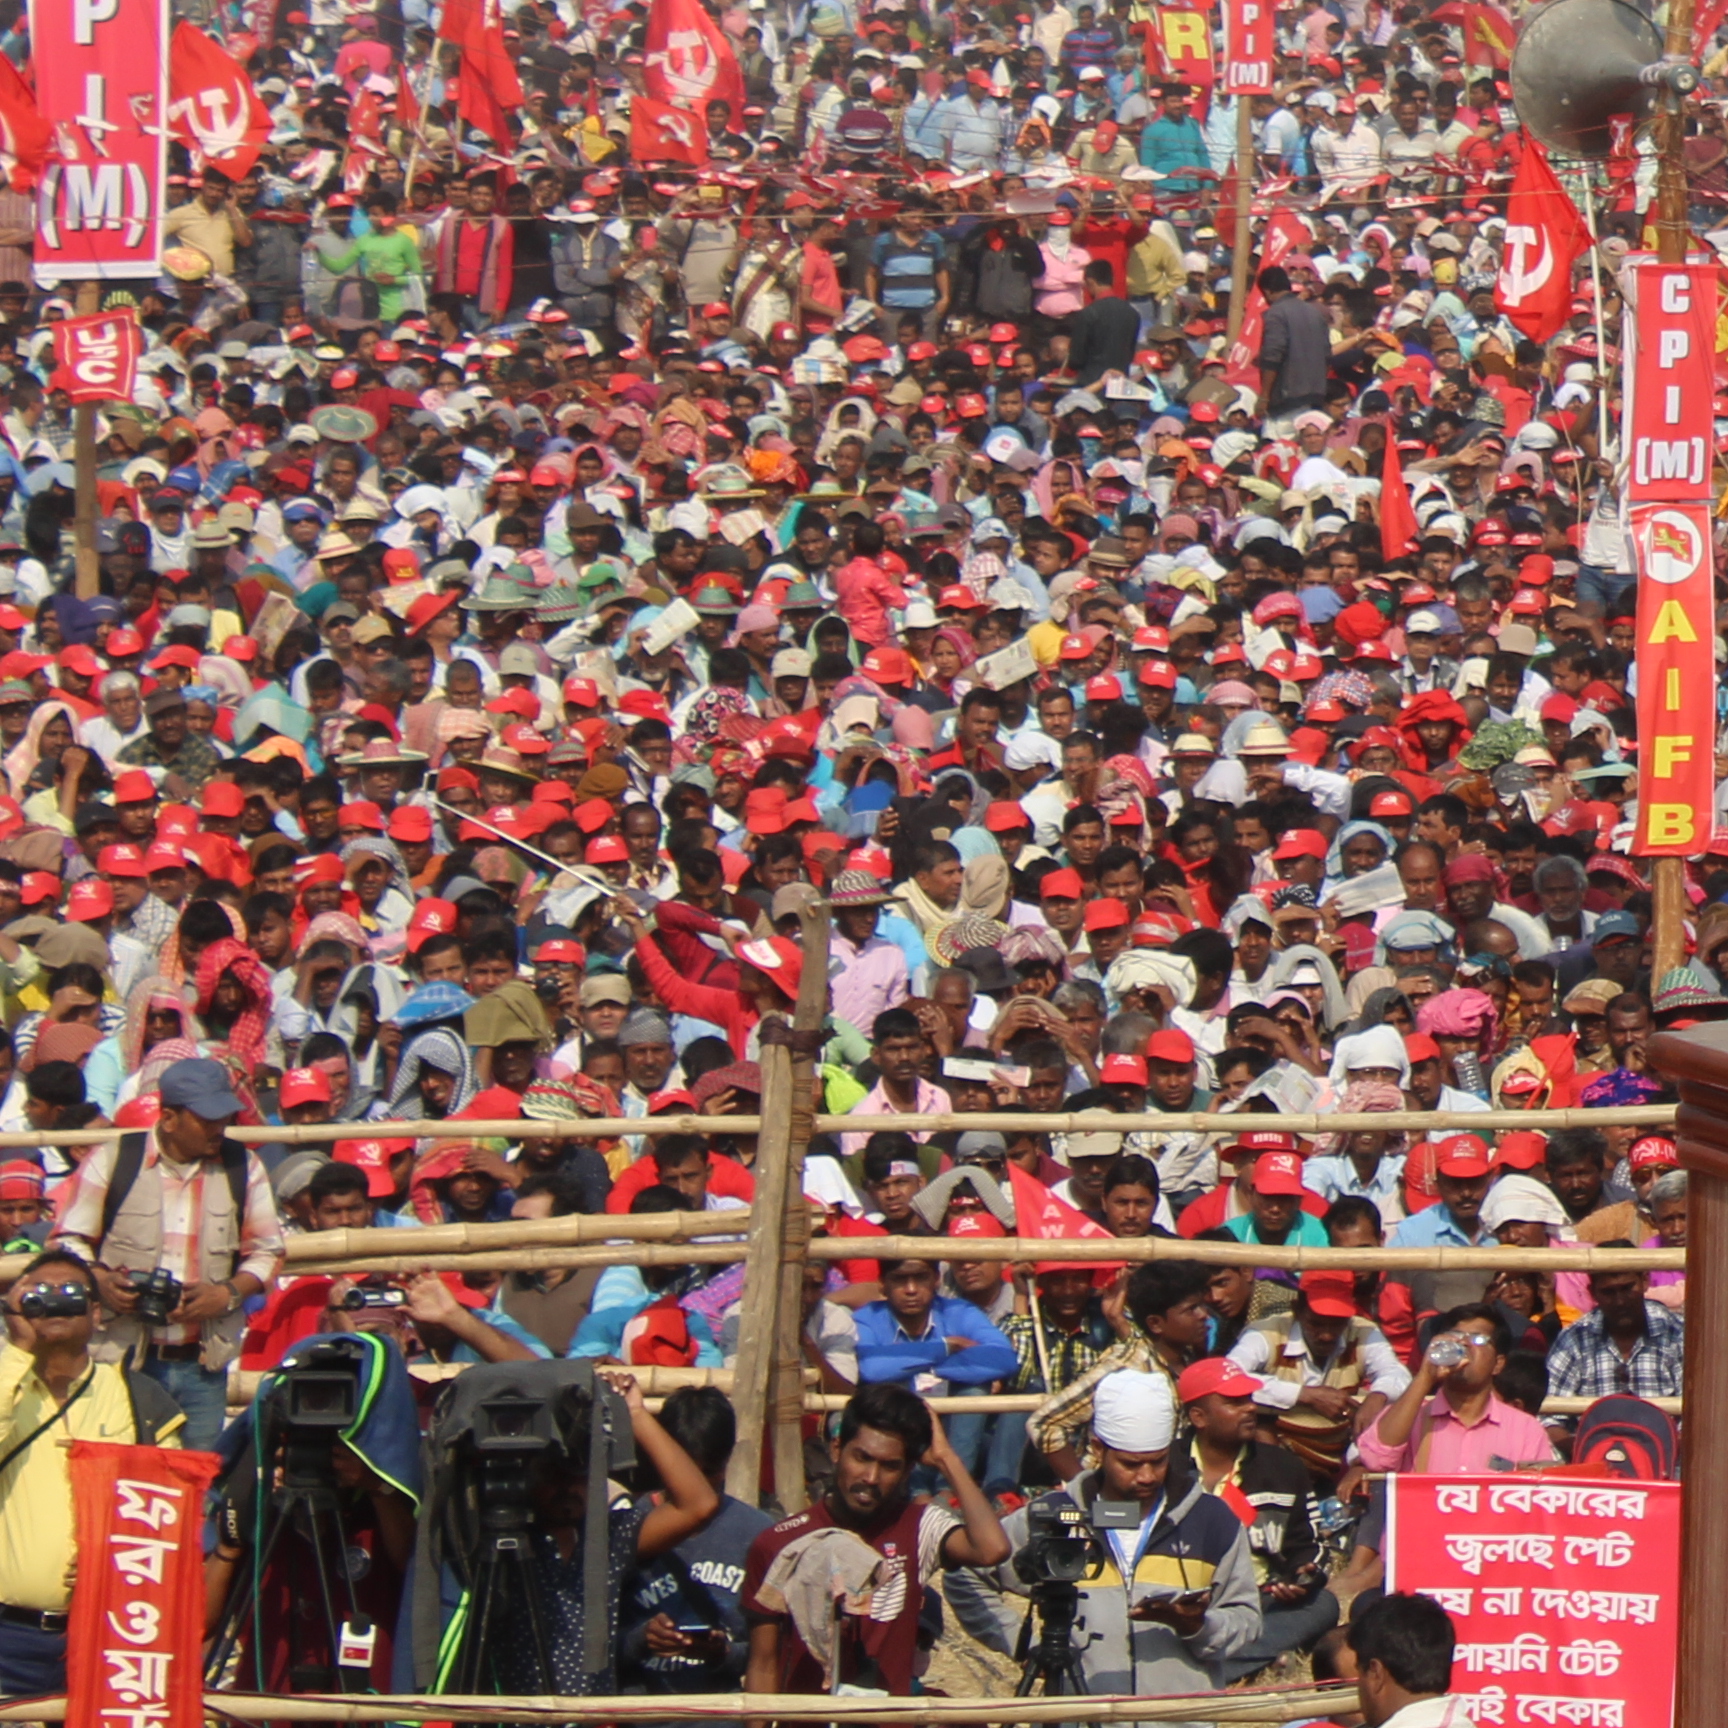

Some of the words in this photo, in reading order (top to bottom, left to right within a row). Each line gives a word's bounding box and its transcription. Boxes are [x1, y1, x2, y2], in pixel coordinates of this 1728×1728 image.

[1636, 274, 1705, 487] CPI(M)
[1647, 600, 1697, 847] AIFB
[1435, 1485, 1480, 1513] যে
[1489, 1485, 1648, 1519] বেকারের
[1445, 1534, 1556, 1575] জ্বলছে
[1564, 1531, 1635, 1567] পেট
[1482, 1588, 1523, 1615] না
[1531, 1588, 1661, 1624] দেওয়ায়
[1558, 1639, 1622, 1677] টেট
[1515, 1694, 1625, 1728] বেকার
